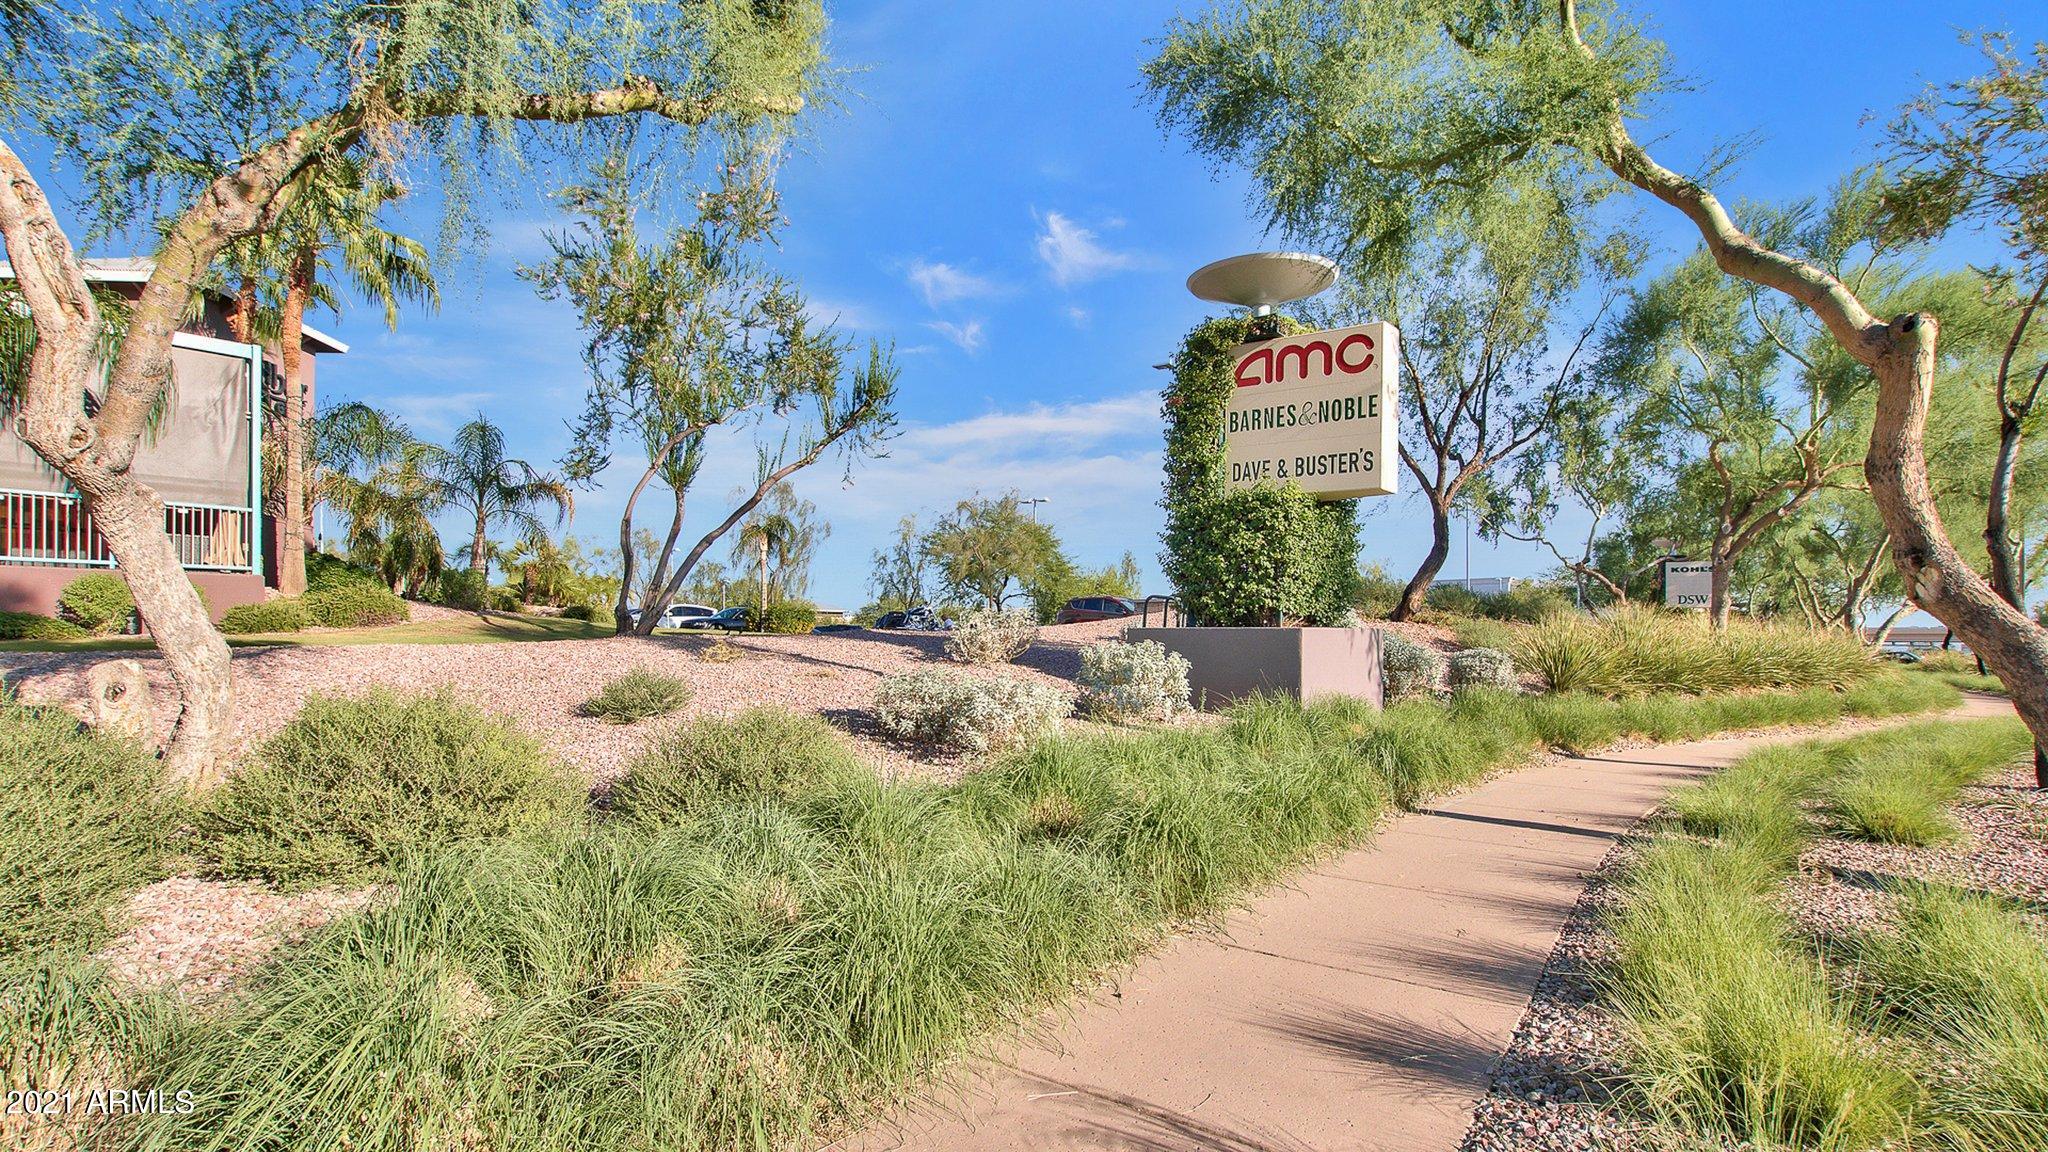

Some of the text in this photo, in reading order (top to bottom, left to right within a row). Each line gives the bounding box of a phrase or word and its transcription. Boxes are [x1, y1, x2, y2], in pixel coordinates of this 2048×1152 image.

[1232, 448, 1374, 482] DAVE & BUSTER'S
[1678, 594, 1709, 605] DSW
